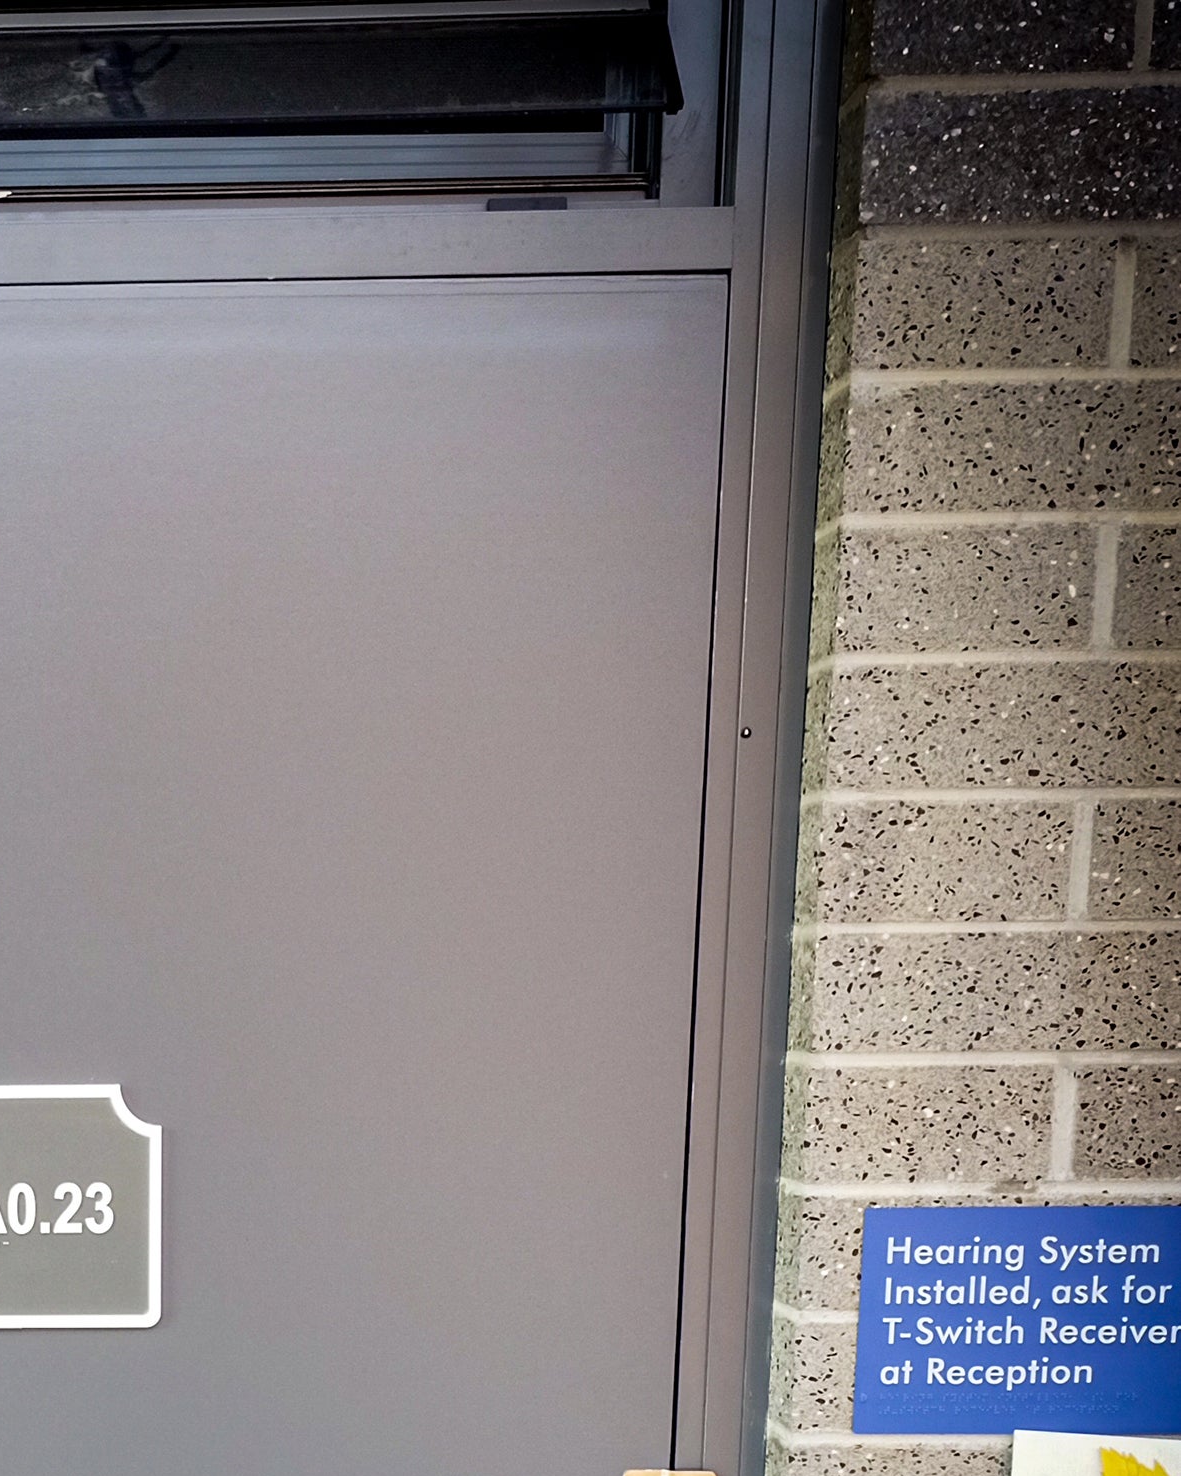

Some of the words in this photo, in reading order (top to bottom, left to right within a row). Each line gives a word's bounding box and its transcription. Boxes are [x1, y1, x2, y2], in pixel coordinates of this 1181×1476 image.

[886, 1236, 1025, 1271] Hearing
[1039, 1236, 1160, 1271] System
[884, 1275, 1041, 1310] Installed,
[1051, 1276, 1108, 1305] ask
[1121, 1275, 1172, 1304] for
[882, 1316, 1024, 1345] T-Switch
[1039, 1317, 1181, 1344] Receiver
[880, 1360, 913, 1385] at
[926, 1357, 1093, 1391] Reception
